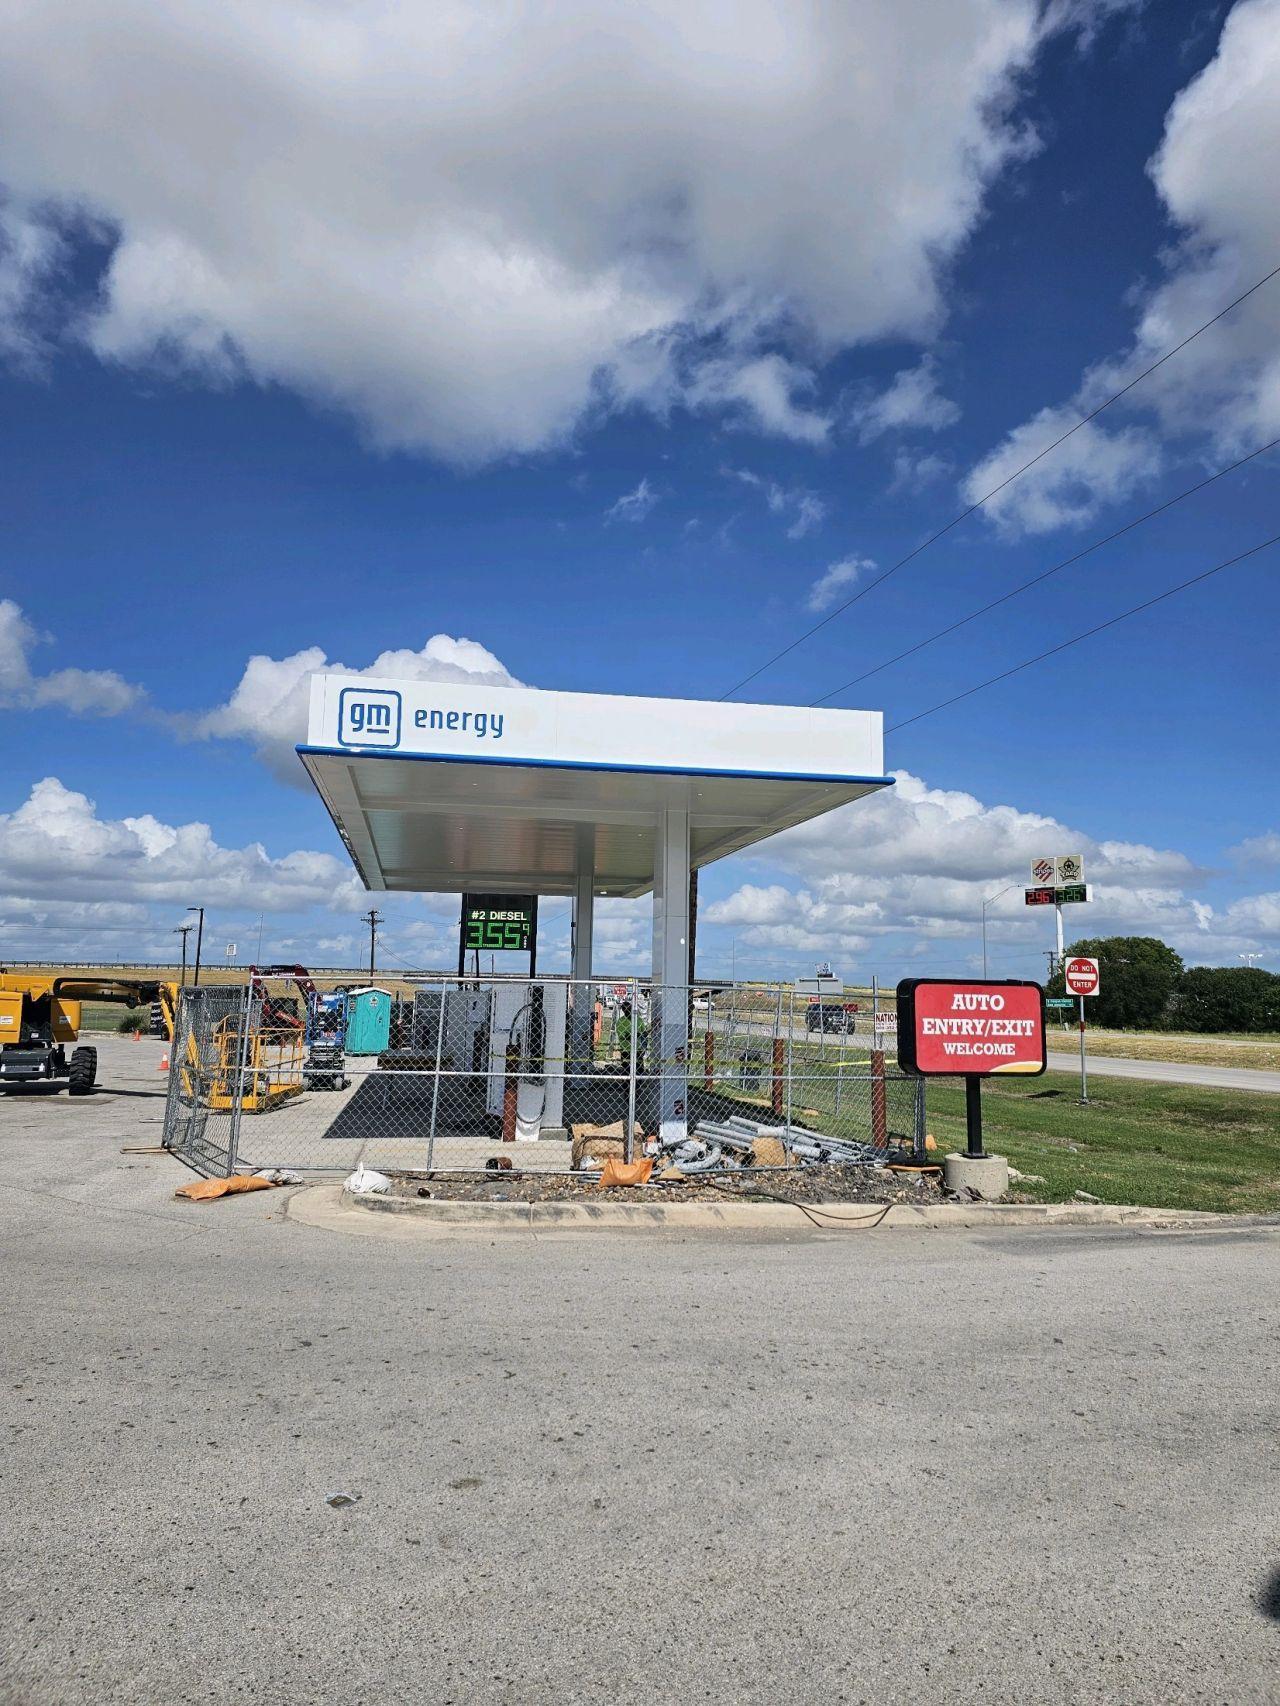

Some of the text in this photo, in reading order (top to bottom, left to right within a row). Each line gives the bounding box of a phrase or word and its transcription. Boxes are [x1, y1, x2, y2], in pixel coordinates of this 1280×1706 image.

[350, 703, 504, 739] gm energy
[472, 911, 527, 920] #2 DIESEL
[1070, 964, 1079, 972] DO
[950, 993, 1005, 1011] AUTO
[922, 1017, 1035, 1037] ENTRY/EXIT
[943, 1042, 1016, 1056] WELCOME
